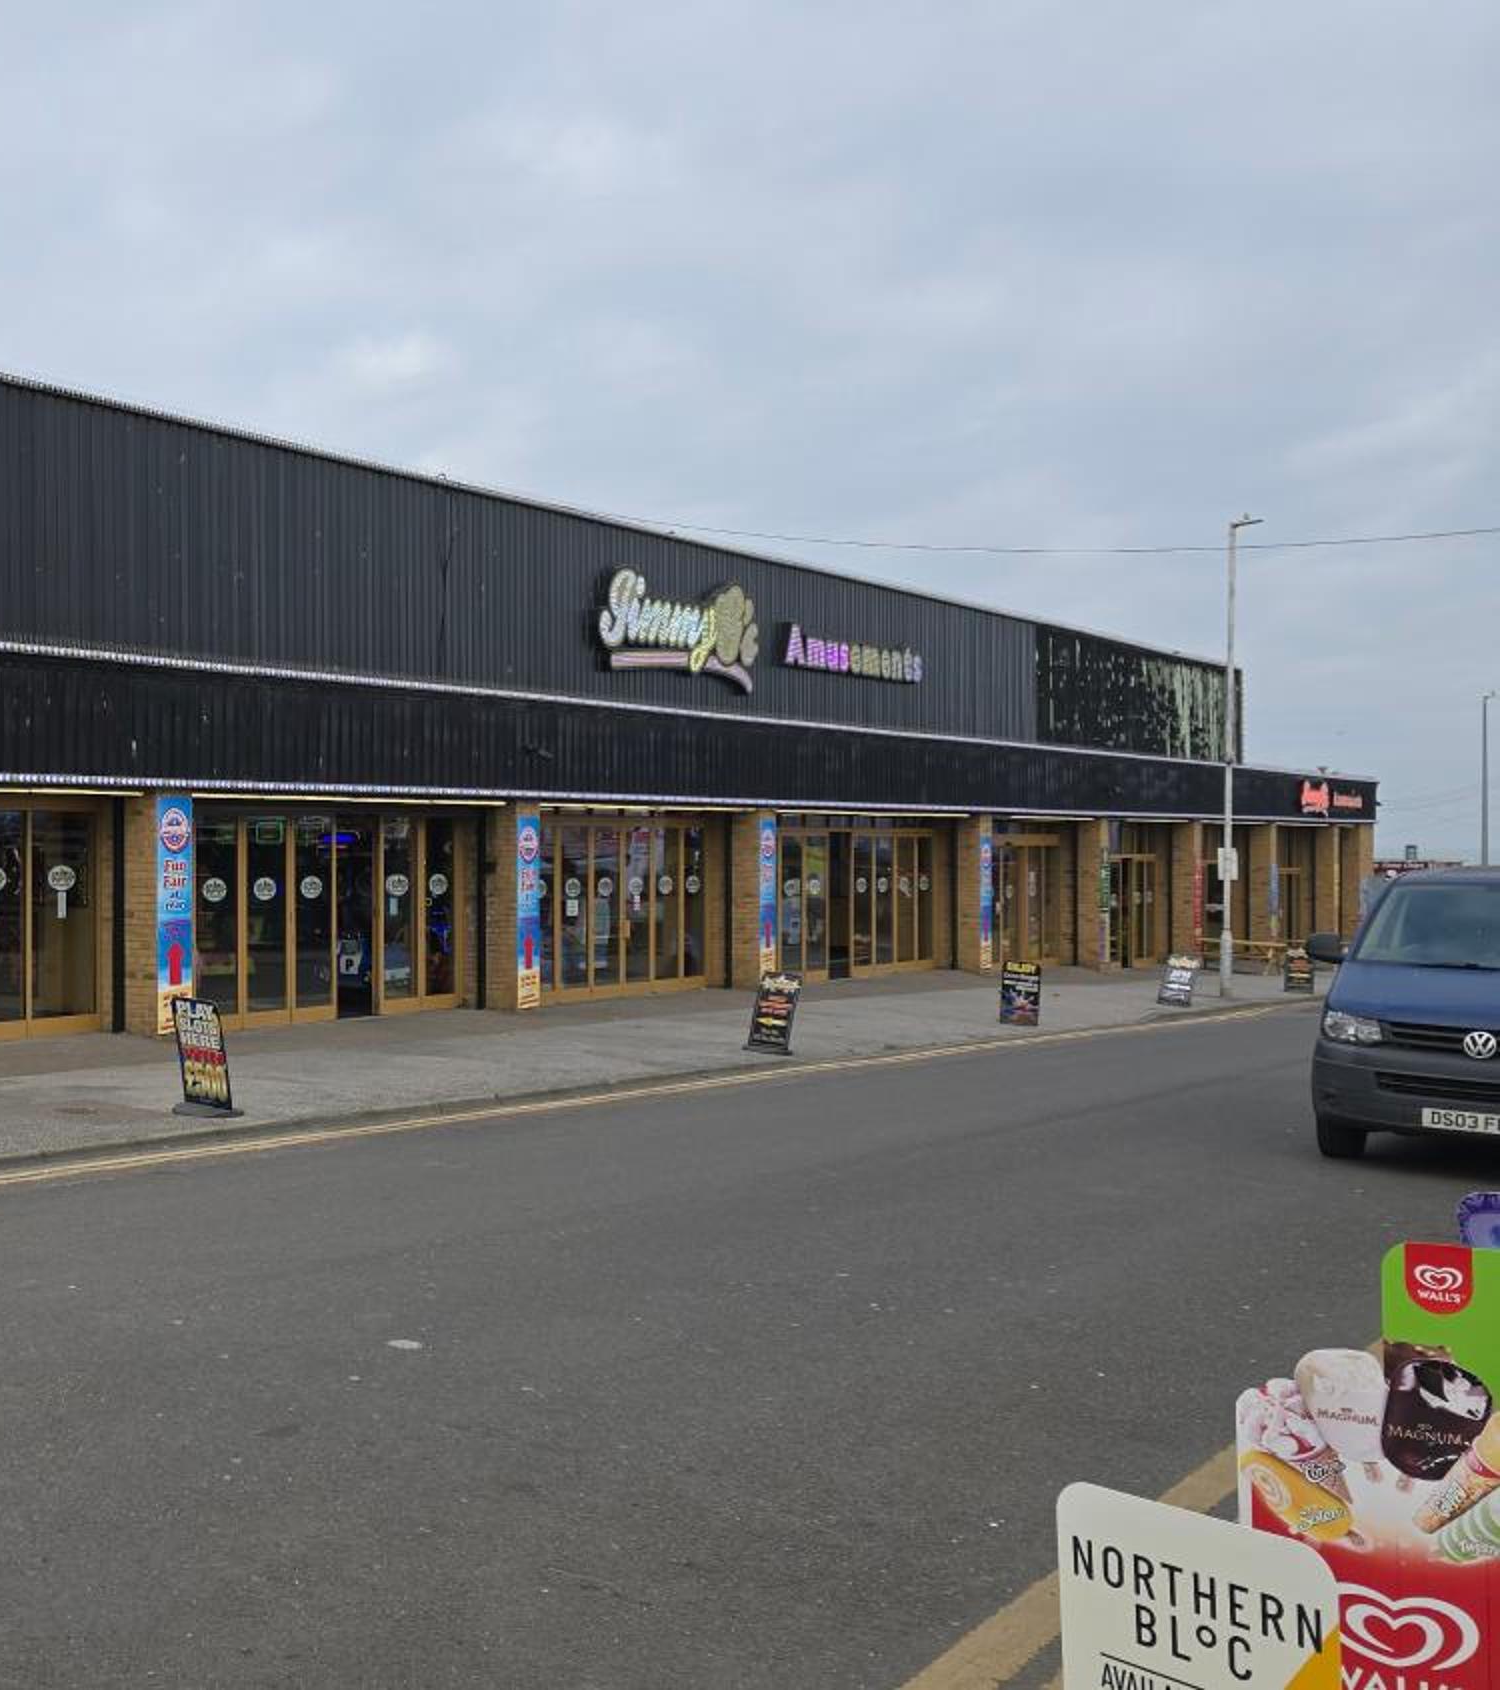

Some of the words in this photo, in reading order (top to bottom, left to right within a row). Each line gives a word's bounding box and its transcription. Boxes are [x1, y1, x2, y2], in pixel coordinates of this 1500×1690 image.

[785, 622, 923, 684] Amusements
[163, 859, 187, 873] Fun
[163, 875, 187, 889] Fair
[176, 1000, 214, 1020] PLAY
[179, 1017, 220, 1036] SLOTS
[180, 1031, 221, 1050] HERE
[1431, 1111, 1478, 1129] DS03
[1485, 1116, 1500, 1131] F
[1417, 1289, 1461, 1304] WALL'S
[1317, 1408, 1379, 1426] MAGNUM
[1387, 1424, 1463, 1447] MAGNUM
[1072, 1535, 1323, 1654] NORTHERN
